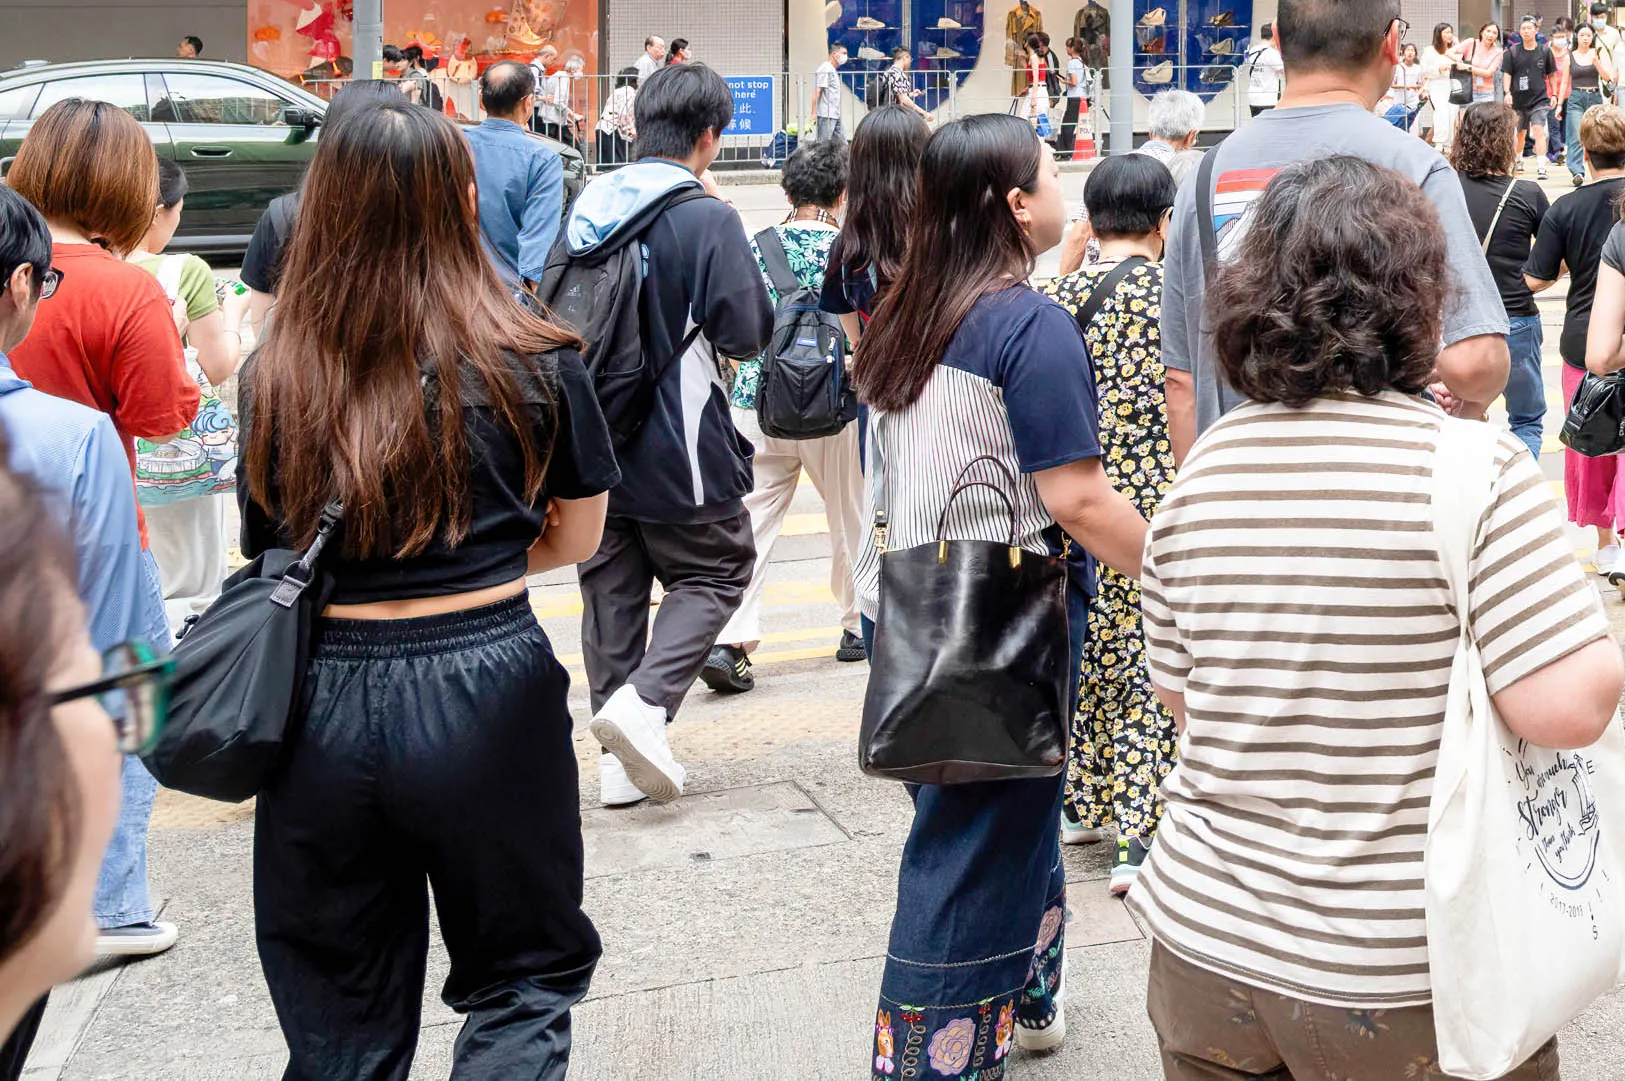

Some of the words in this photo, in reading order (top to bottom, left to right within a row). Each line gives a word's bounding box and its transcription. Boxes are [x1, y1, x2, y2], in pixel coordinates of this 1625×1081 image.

[729, 81, 745, 89] not
[747, 80, 769, 90] stop
[735, 90, 756, 99] here
